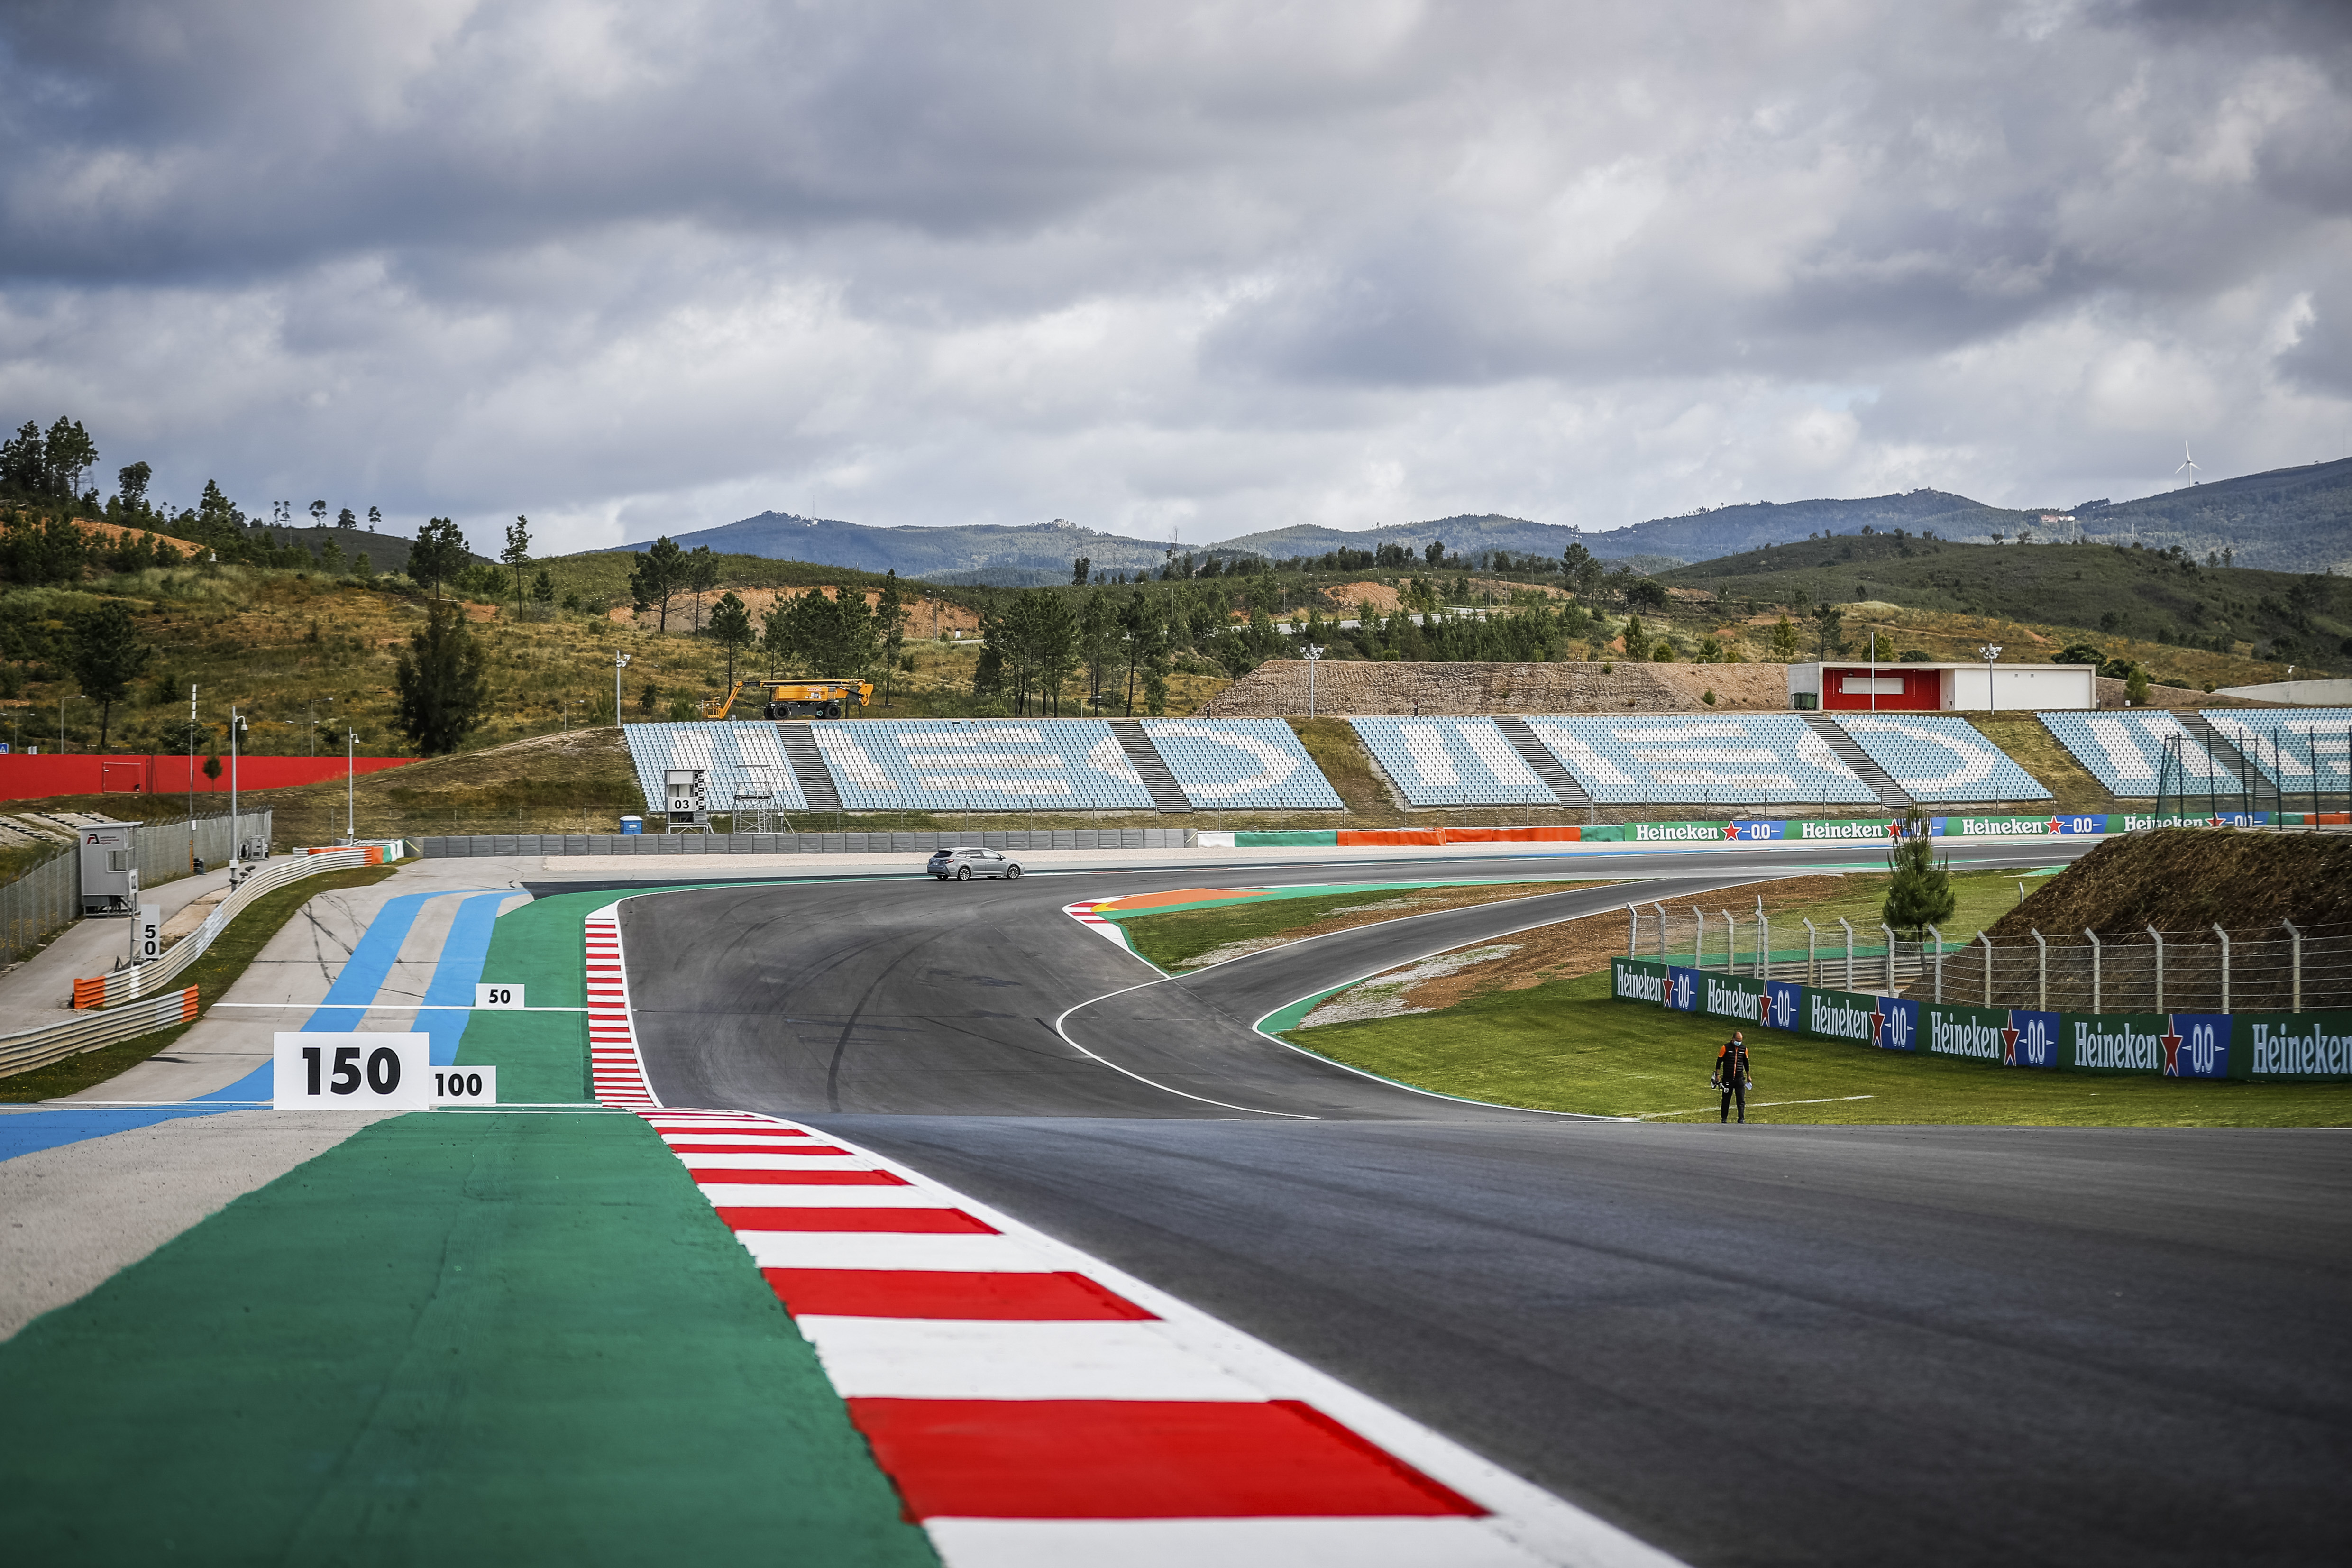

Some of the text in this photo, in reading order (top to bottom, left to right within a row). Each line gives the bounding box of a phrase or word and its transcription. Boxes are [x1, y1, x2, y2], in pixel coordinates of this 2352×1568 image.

[675, 800, 689, 809] 03
[1636, 824, 1770, 841] Heineken 0.0
[1802, 823, 1884, 839] Heineken
[1962, 817, 2093, 834] Heineken 0.0
[2235, 815, 2252, 826] 00
[489, 989, 511, 1004] 50
[1616, 964, 1690, 1009] Heineken 0.0
[1707, 978, 1790, 1027] Heineken 0.0
[1811, 995, 1906, 1047] Heineken 0.0
[1931, 1011, 2045, 1064] Heineken 0.0
[2075, 1022, 2214, 1073] Heineken 0.0
[302, 1047, 401, 1095] 150
[435, 1073, 482, 1097] 100
